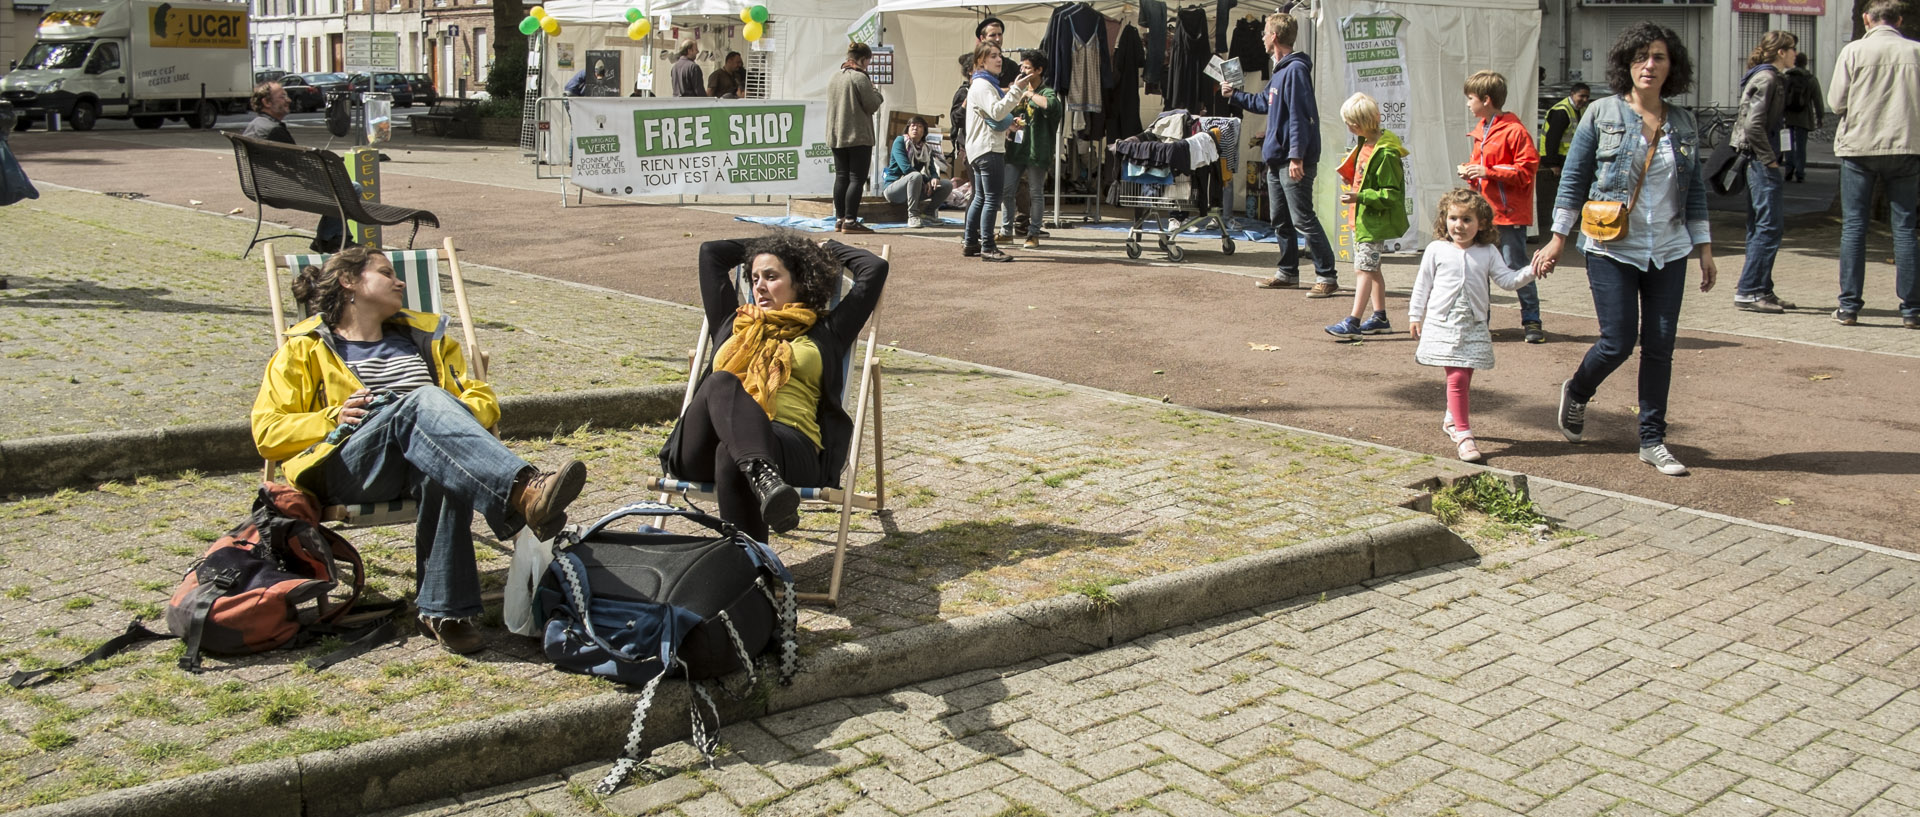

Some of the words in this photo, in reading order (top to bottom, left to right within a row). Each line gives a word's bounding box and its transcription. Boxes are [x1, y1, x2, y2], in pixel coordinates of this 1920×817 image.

[188, 14, 240, 37] ucar
[1584, 51, 1591, 60] 8
[1383, 102, 1406, 113] SHOP
[643, 115, 711, 151] FREE
[728, 112, 793, 146] SHOP
[588, 142, 617, 153] VERTE
[590, 136, 616, 144] BRIGADE
[640, 158, 674, 172] RIEN
[679, 155, 716, 170] N'EST
[722, 153, 733, 167] À
[739, 152, 795, 166] VENDRE
[644, 173, 677, 187] TOUT
[684, 171, 708, 183] EST
[715, 168, 725, 182] À
[731, 166, 796, 182] PRENDRE
